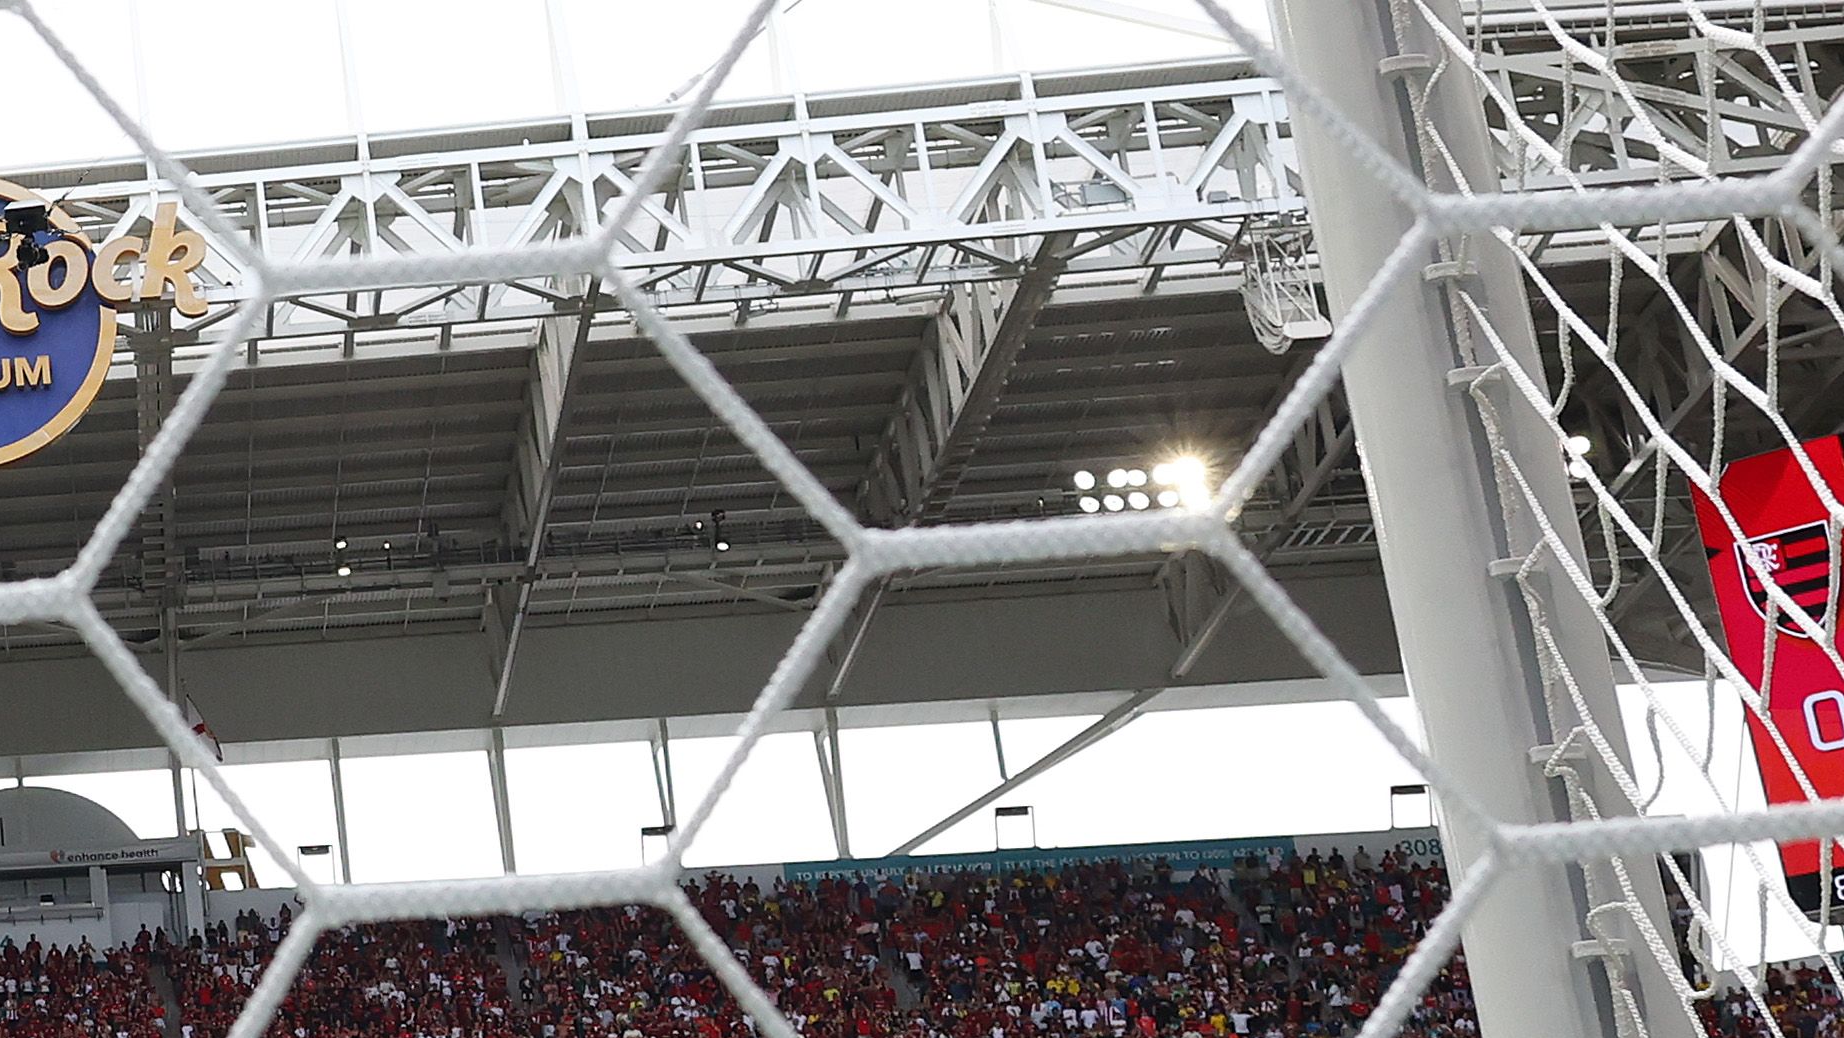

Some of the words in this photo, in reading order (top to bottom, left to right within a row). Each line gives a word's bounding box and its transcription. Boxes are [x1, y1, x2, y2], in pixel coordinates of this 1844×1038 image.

[67, 850, 119, 863] enhance
[121, 848, 159, 860] health
[1402, 840, 1442, 859] 308
